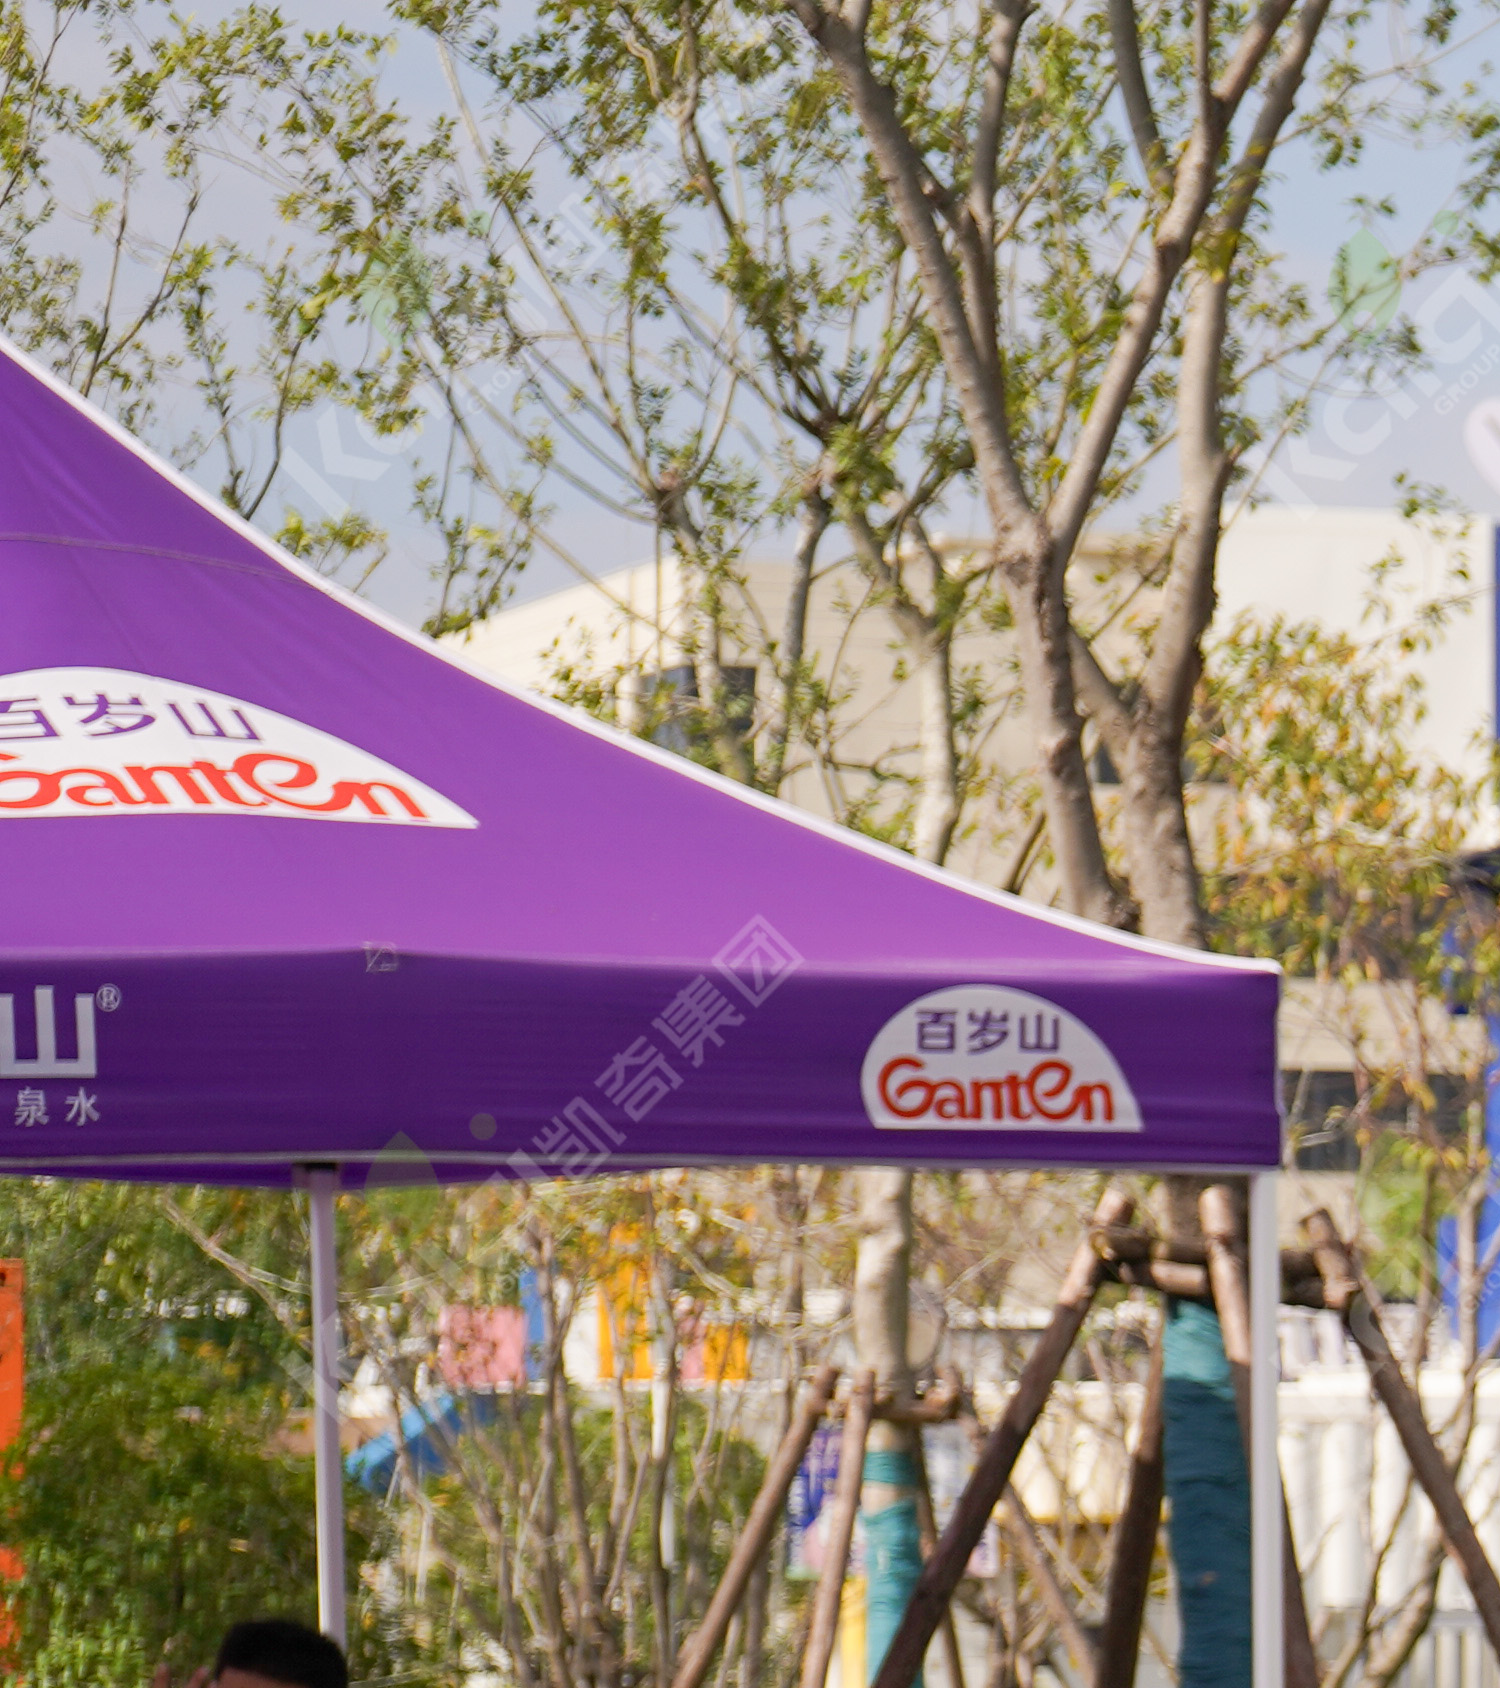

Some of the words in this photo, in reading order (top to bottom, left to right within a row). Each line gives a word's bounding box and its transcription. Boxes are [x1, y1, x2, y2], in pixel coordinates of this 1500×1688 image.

[0, 691, 263, 743] 百岁山
[0, 984, 97, 1080] 山
[914, 1008, 1060, 1054] 百岁山
[14, 1086, 100, 1127] 泉水
